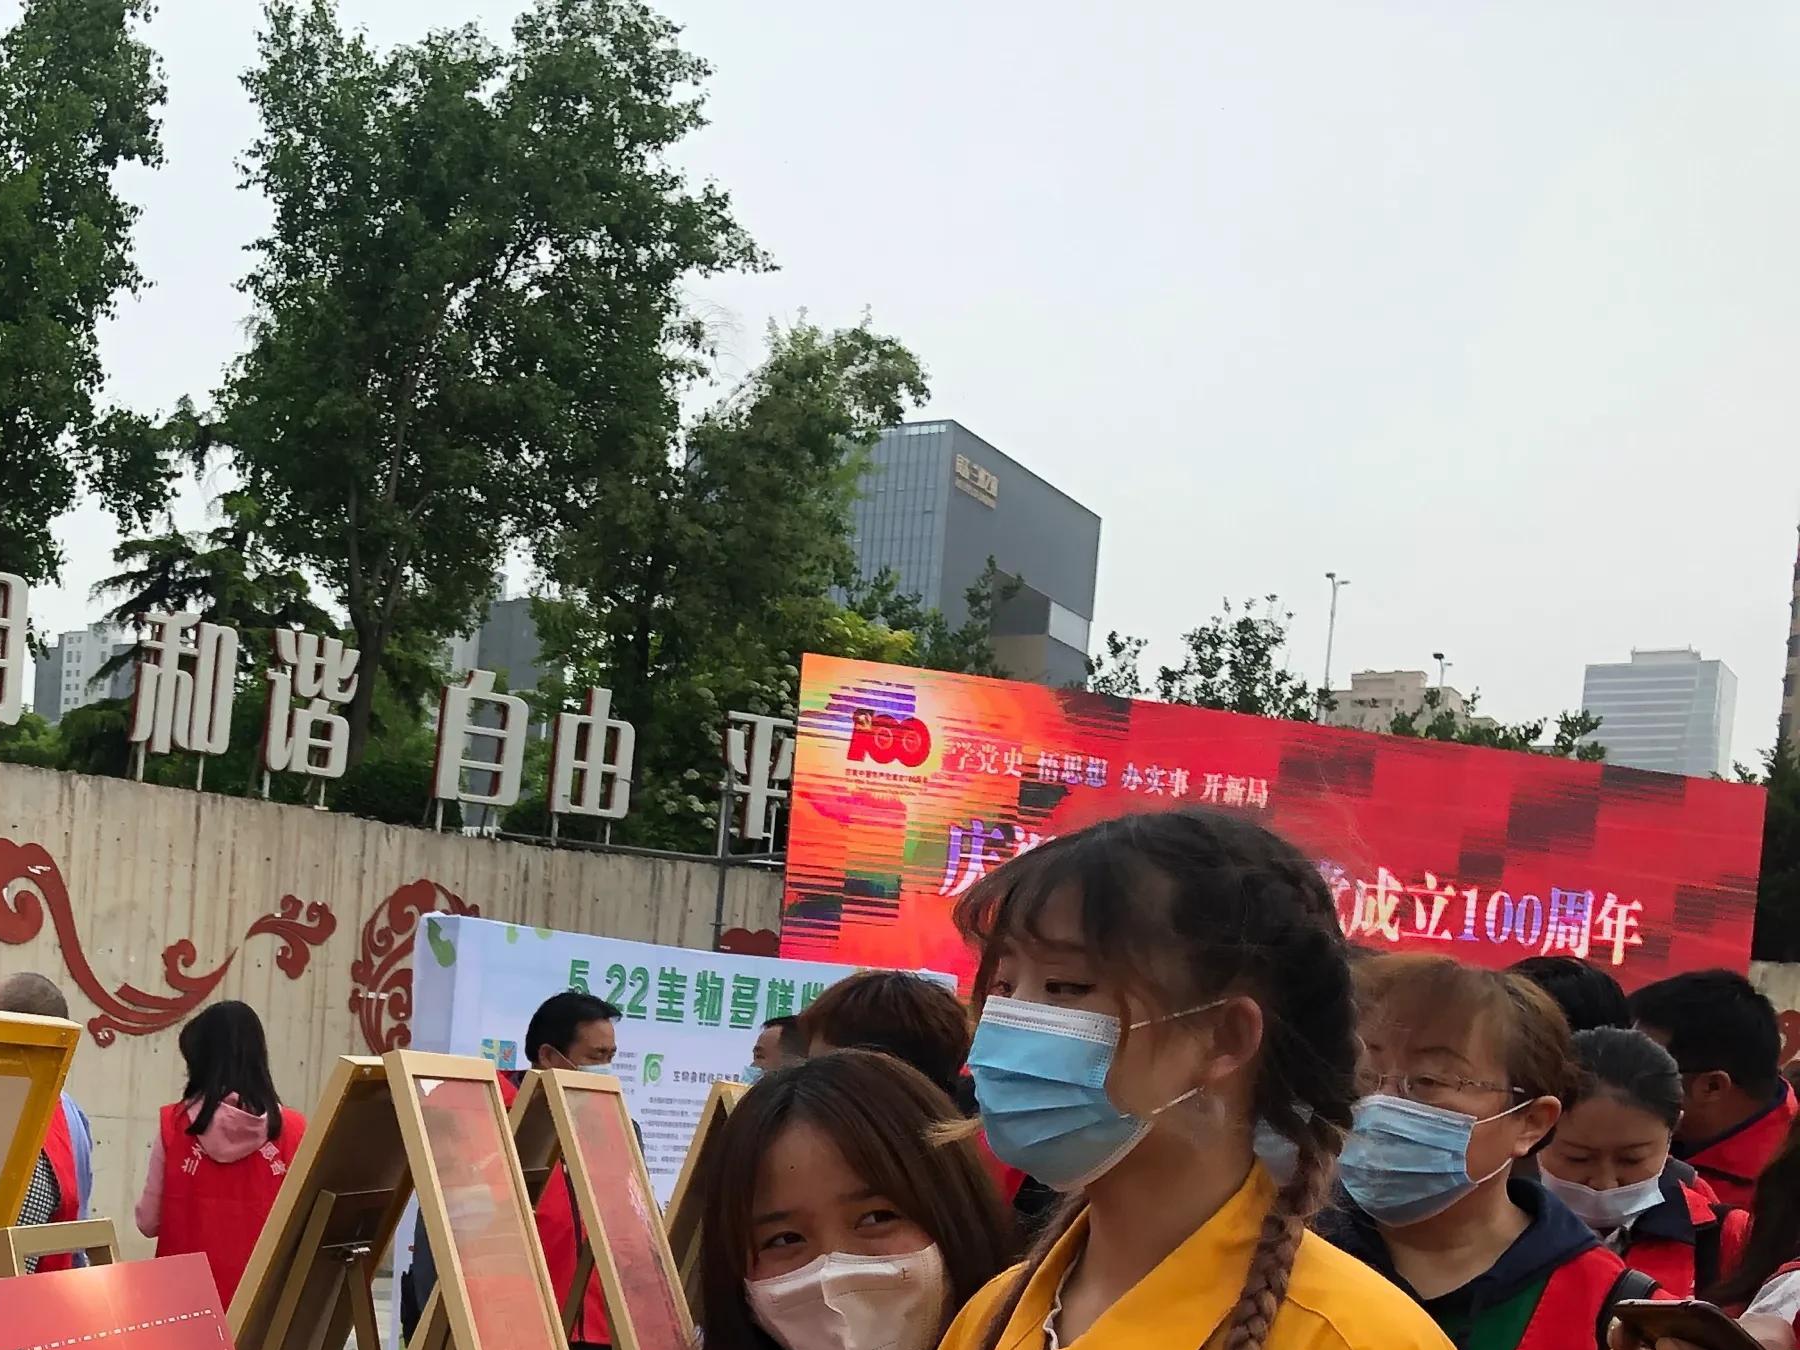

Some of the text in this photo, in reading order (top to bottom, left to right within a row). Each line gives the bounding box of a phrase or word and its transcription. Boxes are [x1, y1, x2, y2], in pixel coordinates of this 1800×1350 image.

[130, 610, 361, 780] 和谐
[432, 668, 635, 821] 自由
[946, 738, 1024, 779] 学党史
[1121, 761, 1190, 797] 办实事
[1200, 772, 1269, 809] 开新局
